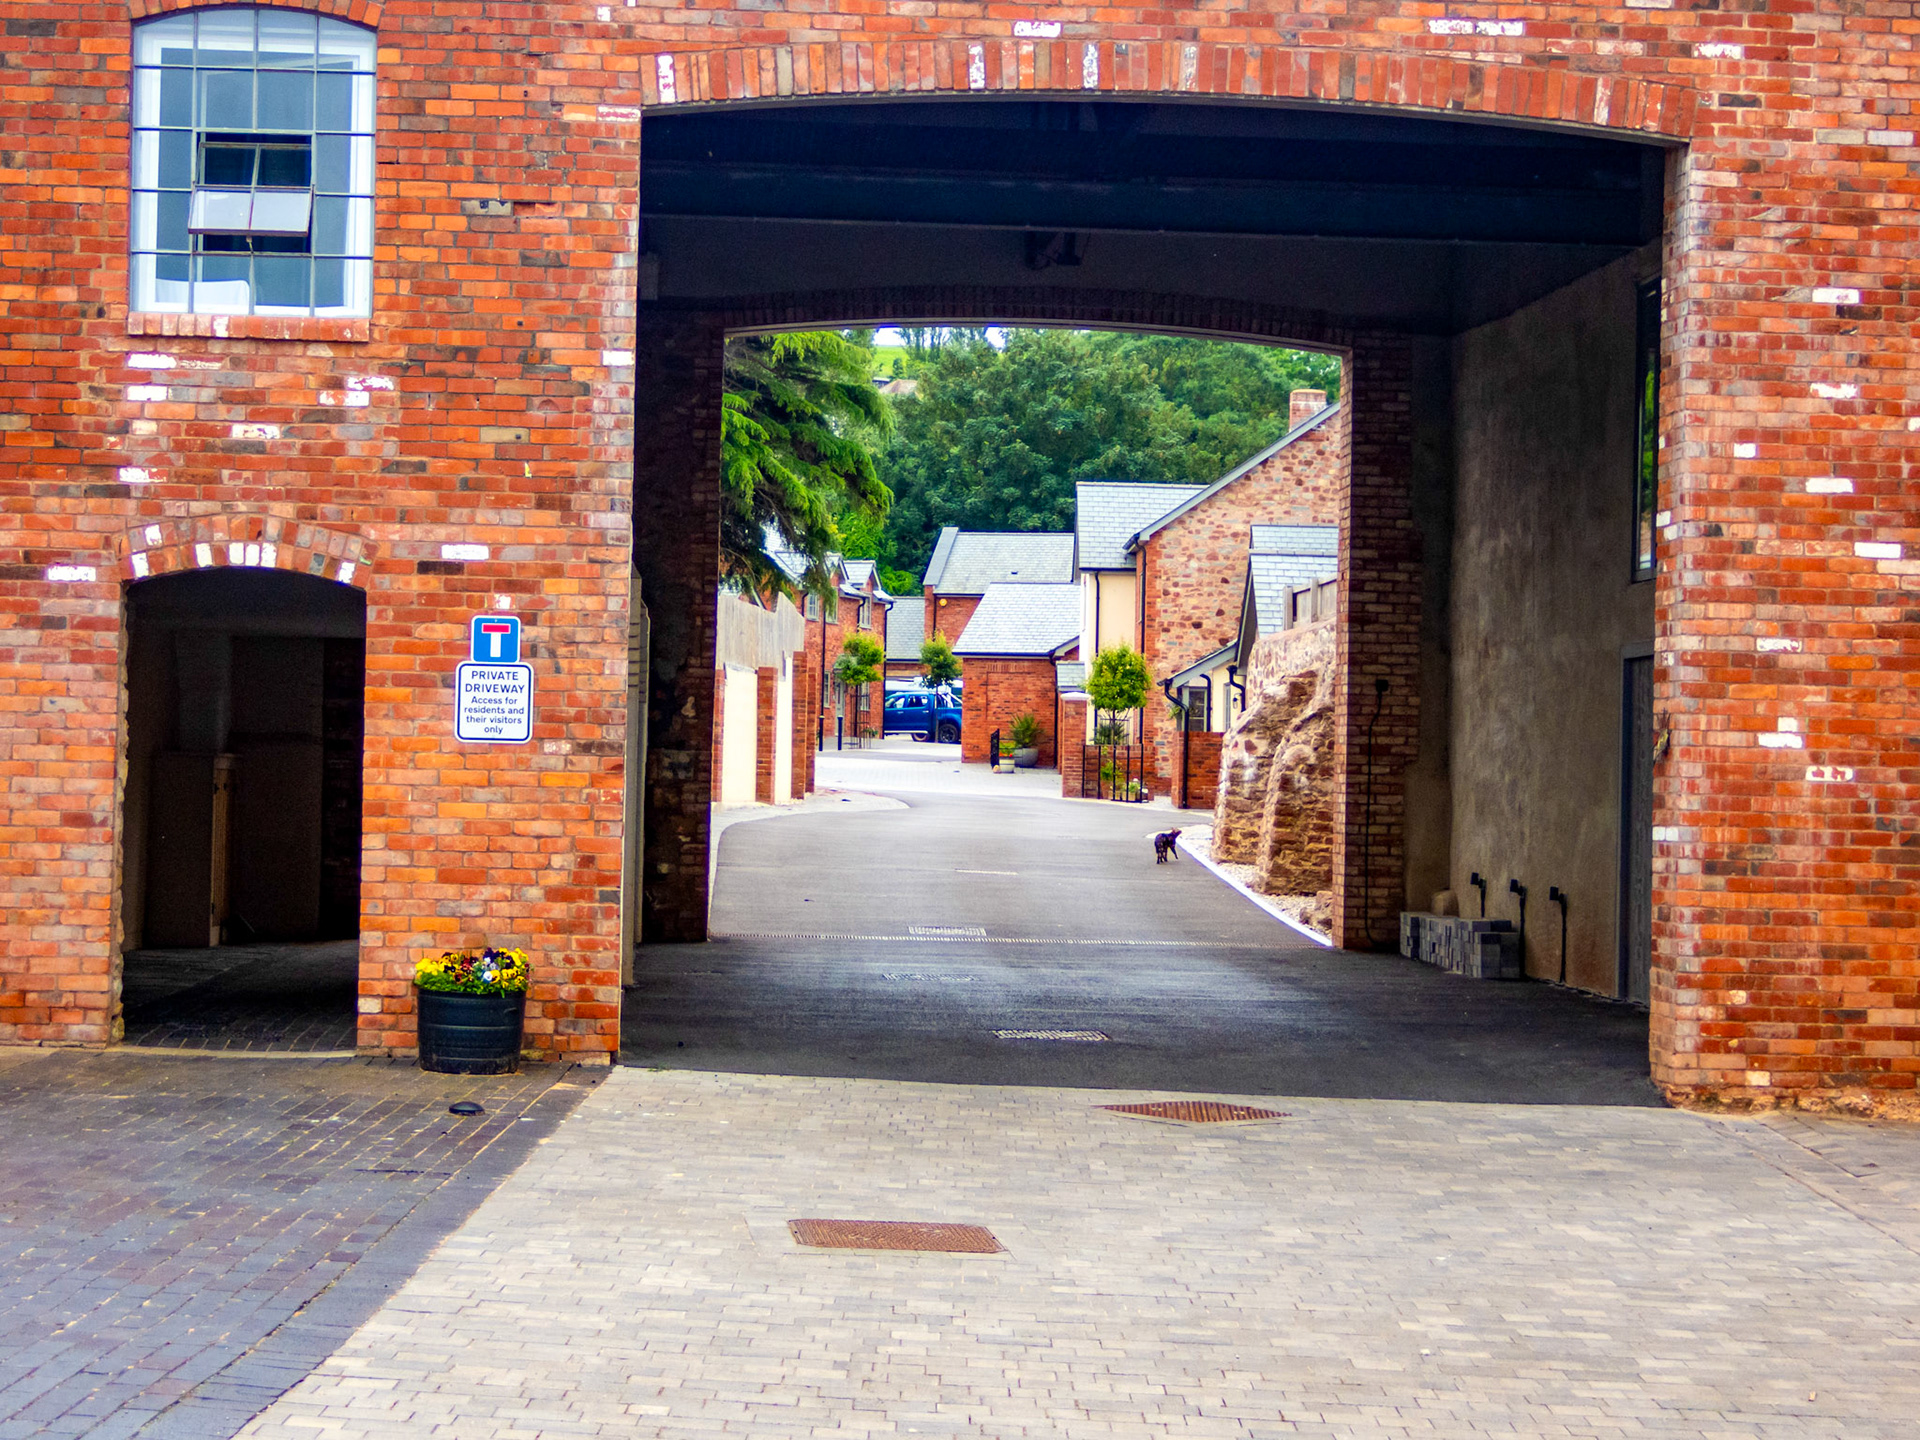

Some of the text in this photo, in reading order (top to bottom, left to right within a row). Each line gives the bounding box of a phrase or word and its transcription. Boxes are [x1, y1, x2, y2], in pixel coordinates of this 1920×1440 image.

[471, 670, 518, 680] PRIVATE
[465, 683, 525, 693] DRIVEWAY
[471, 696, 518, 705] Access for
[464, 706, 505, 714] residents
[466, 715, 522, 724] their visitors
[484, 725, 503, 734] only
